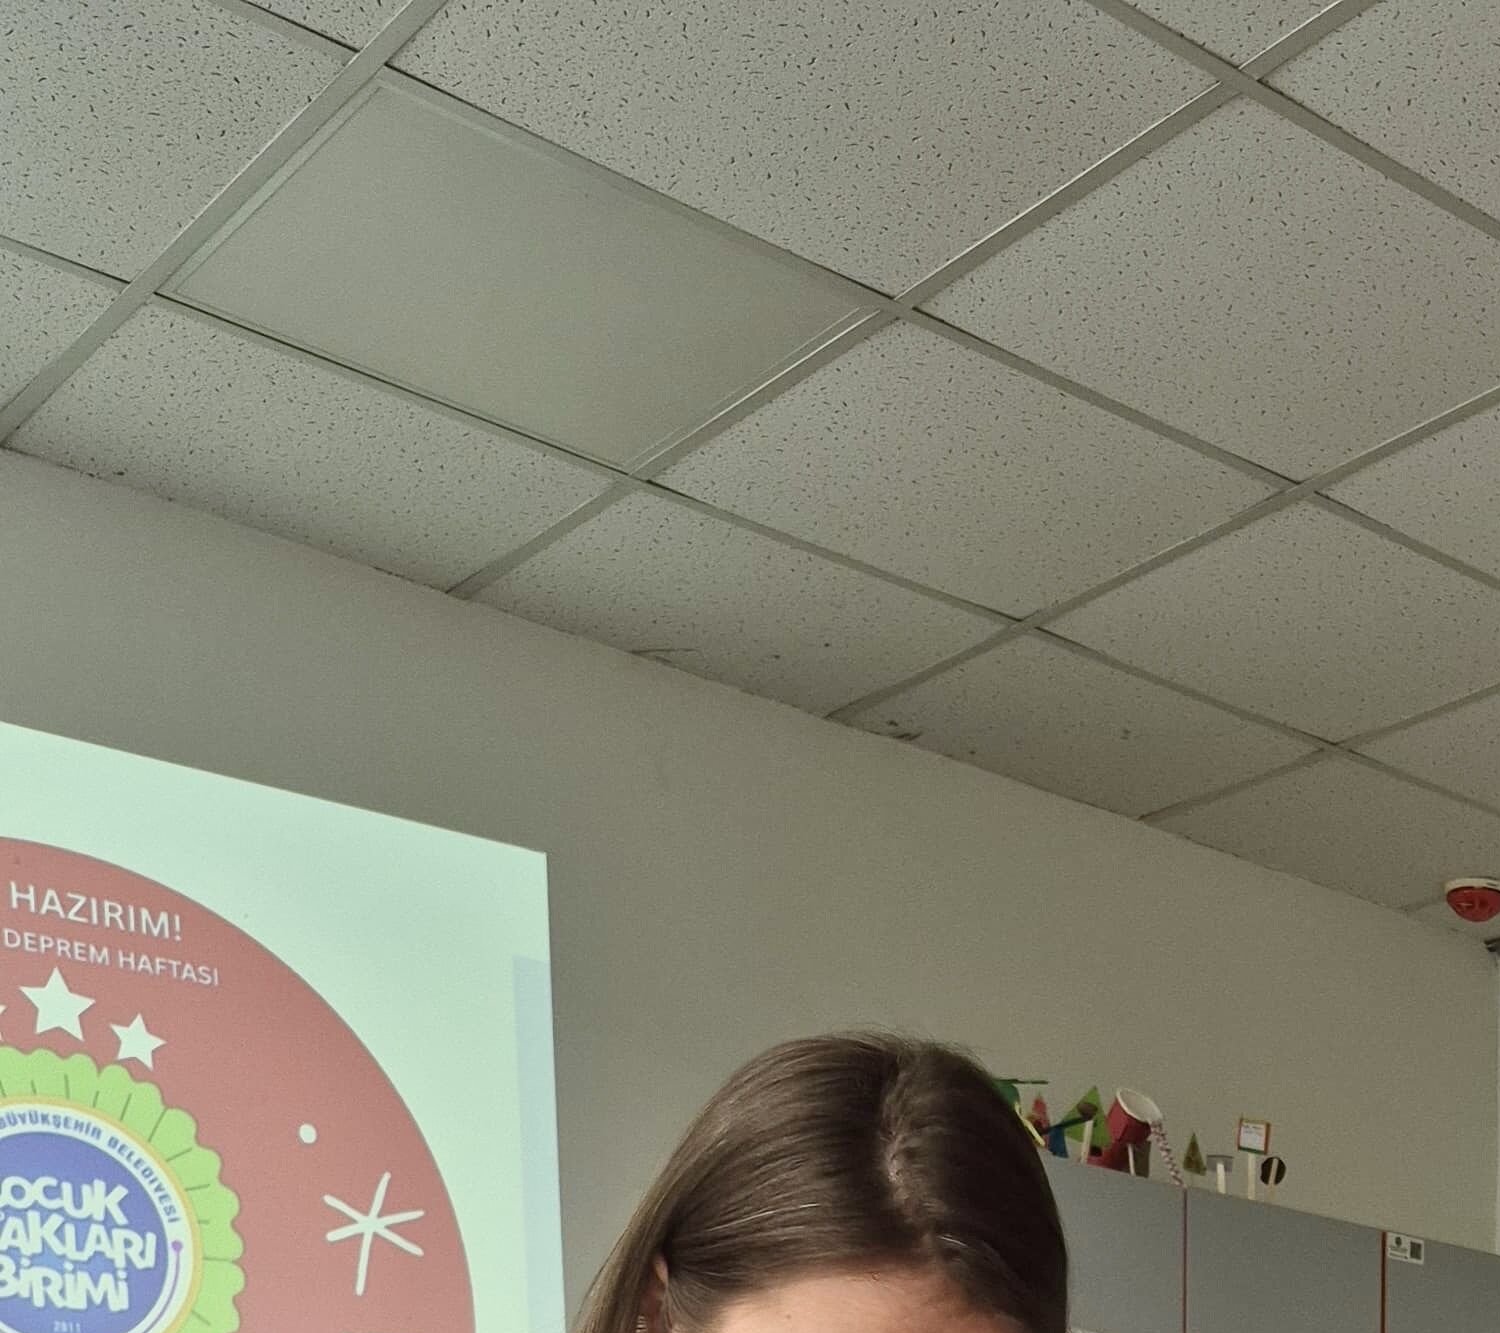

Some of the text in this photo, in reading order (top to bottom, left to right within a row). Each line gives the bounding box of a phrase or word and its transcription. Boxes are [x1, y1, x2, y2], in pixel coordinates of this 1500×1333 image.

[10, 881, 182, 942] HAZIRIM!
[3, 928, 219, 986] DEPREM HAFTASI
[0, 1176, 129, 1226] OCUK
[0, 1210, 157, 1270] AKLARI
